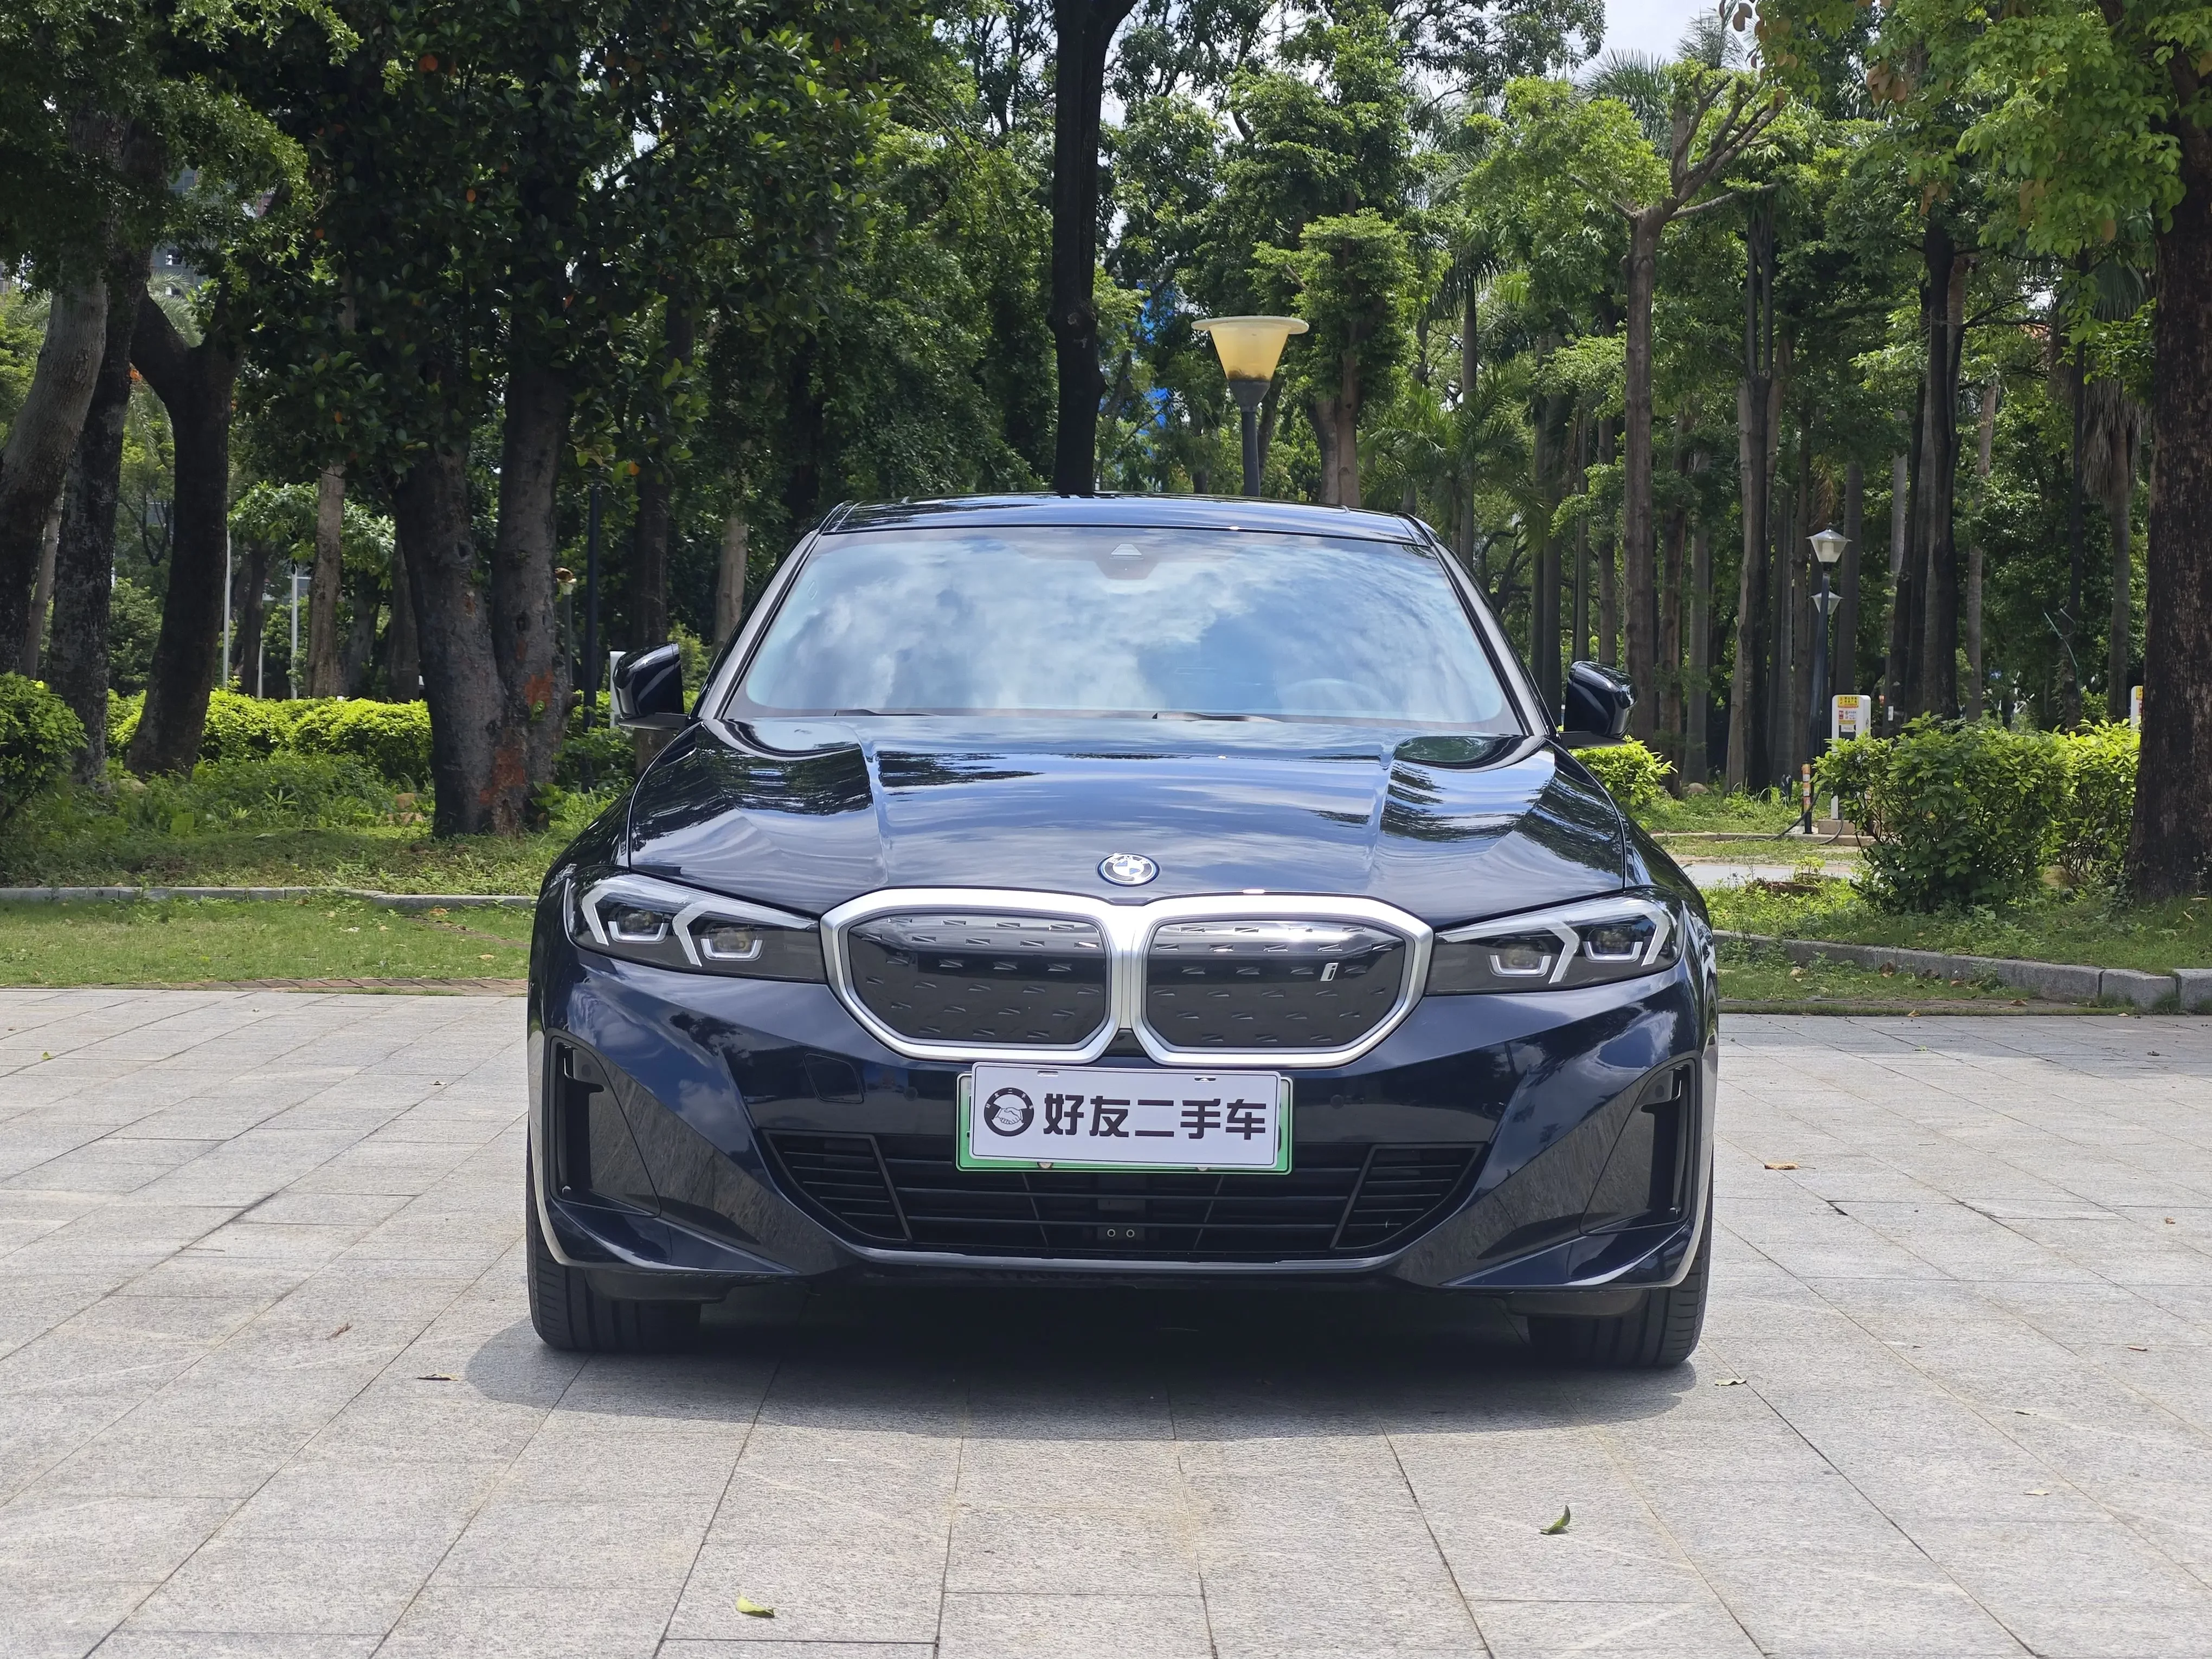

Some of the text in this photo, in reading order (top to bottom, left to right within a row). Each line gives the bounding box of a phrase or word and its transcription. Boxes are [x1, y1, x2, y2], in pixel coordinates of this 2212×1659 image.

[1043, 1092, 1267, 1141] 好友二手车
